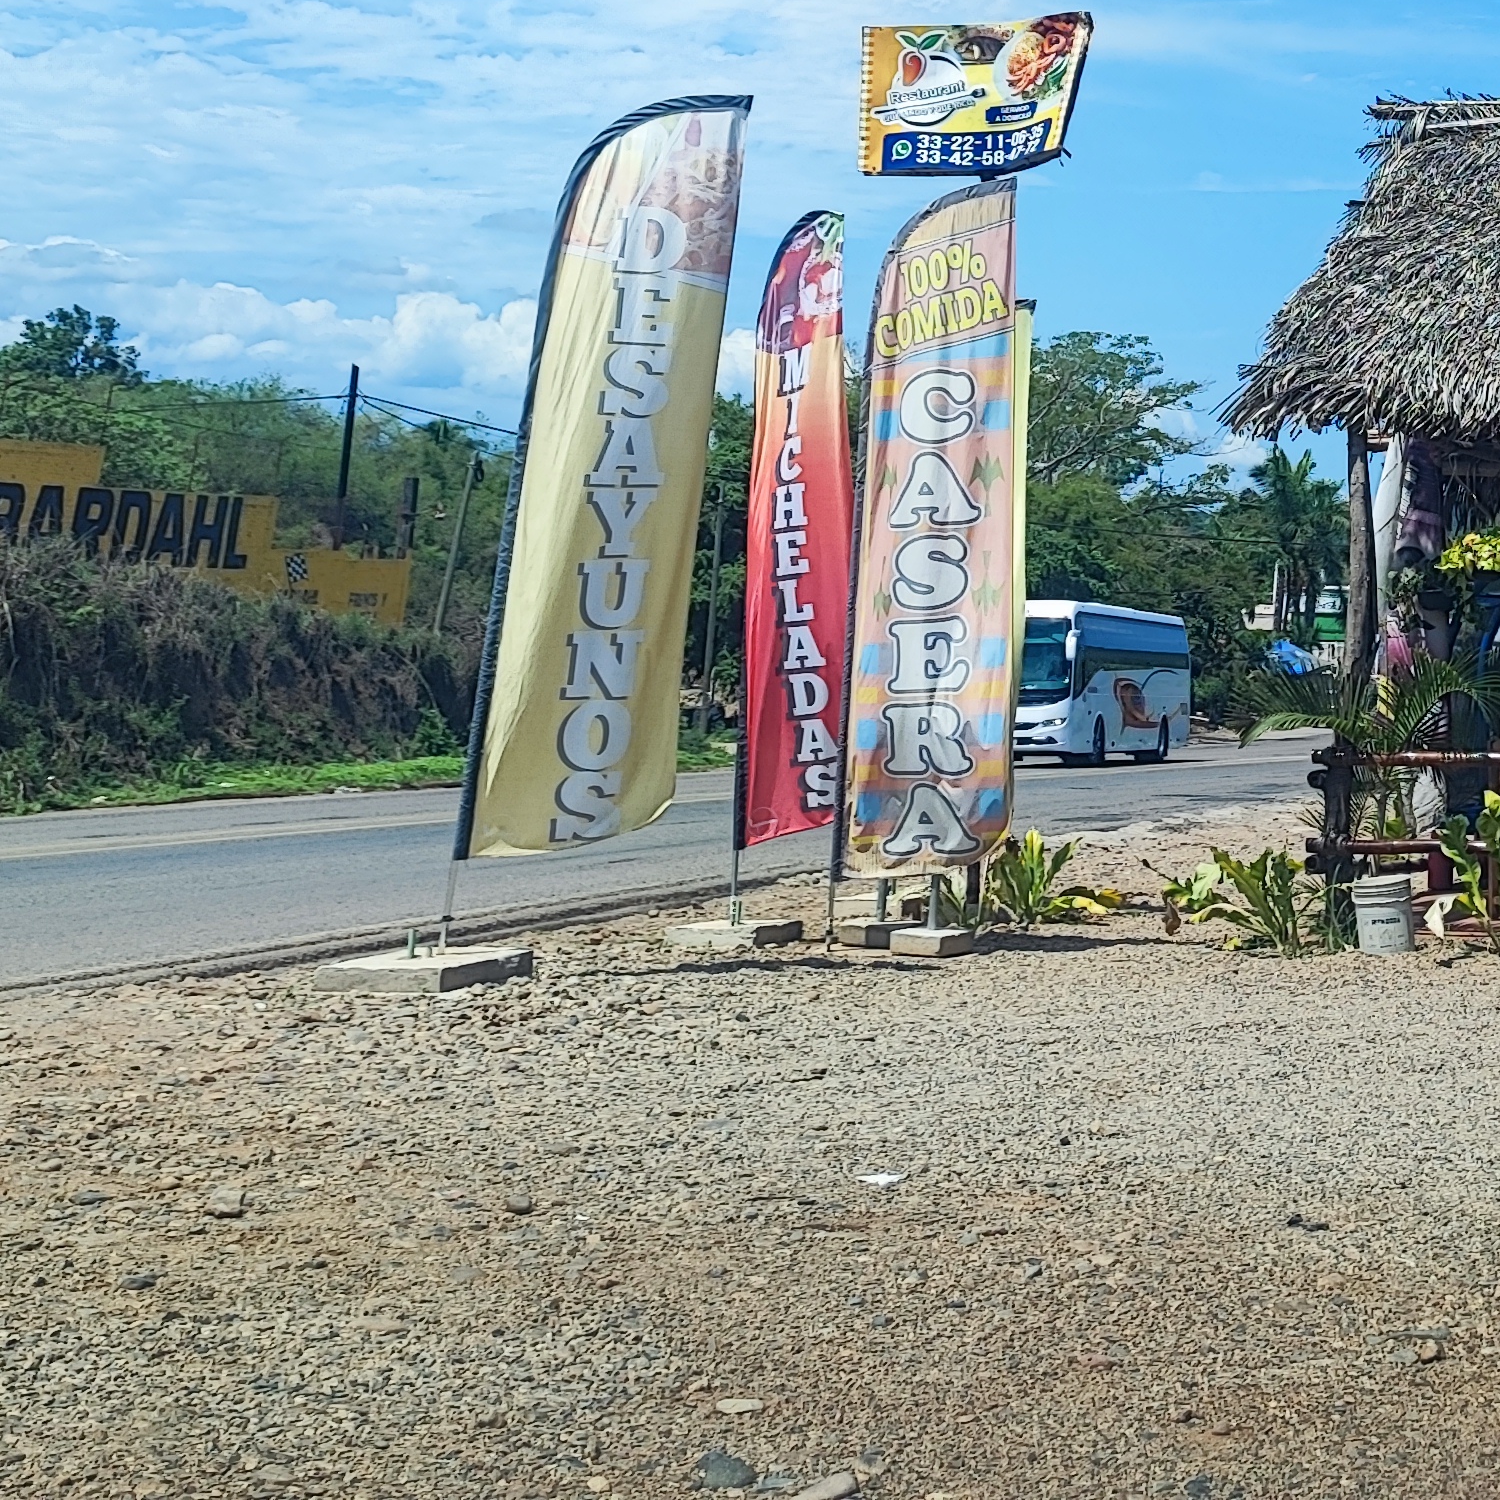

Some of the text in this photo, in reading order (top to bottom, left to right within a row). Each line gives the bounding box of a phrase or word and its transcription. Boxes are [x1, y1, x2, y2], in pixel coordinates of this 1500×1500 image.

[889, 80, 966, 105] Restaurant
[916, 123, 1044, 150] 33-22-11-06-35
[900, 239, 987, 305] 100%
[874, 279, 1009, 359] COMIDA
[549, 205, 688, 844] DESAYUNOS
[772, 343, 839, 811] MICHELADAS
[882, 367, 984, 858] CASERA
